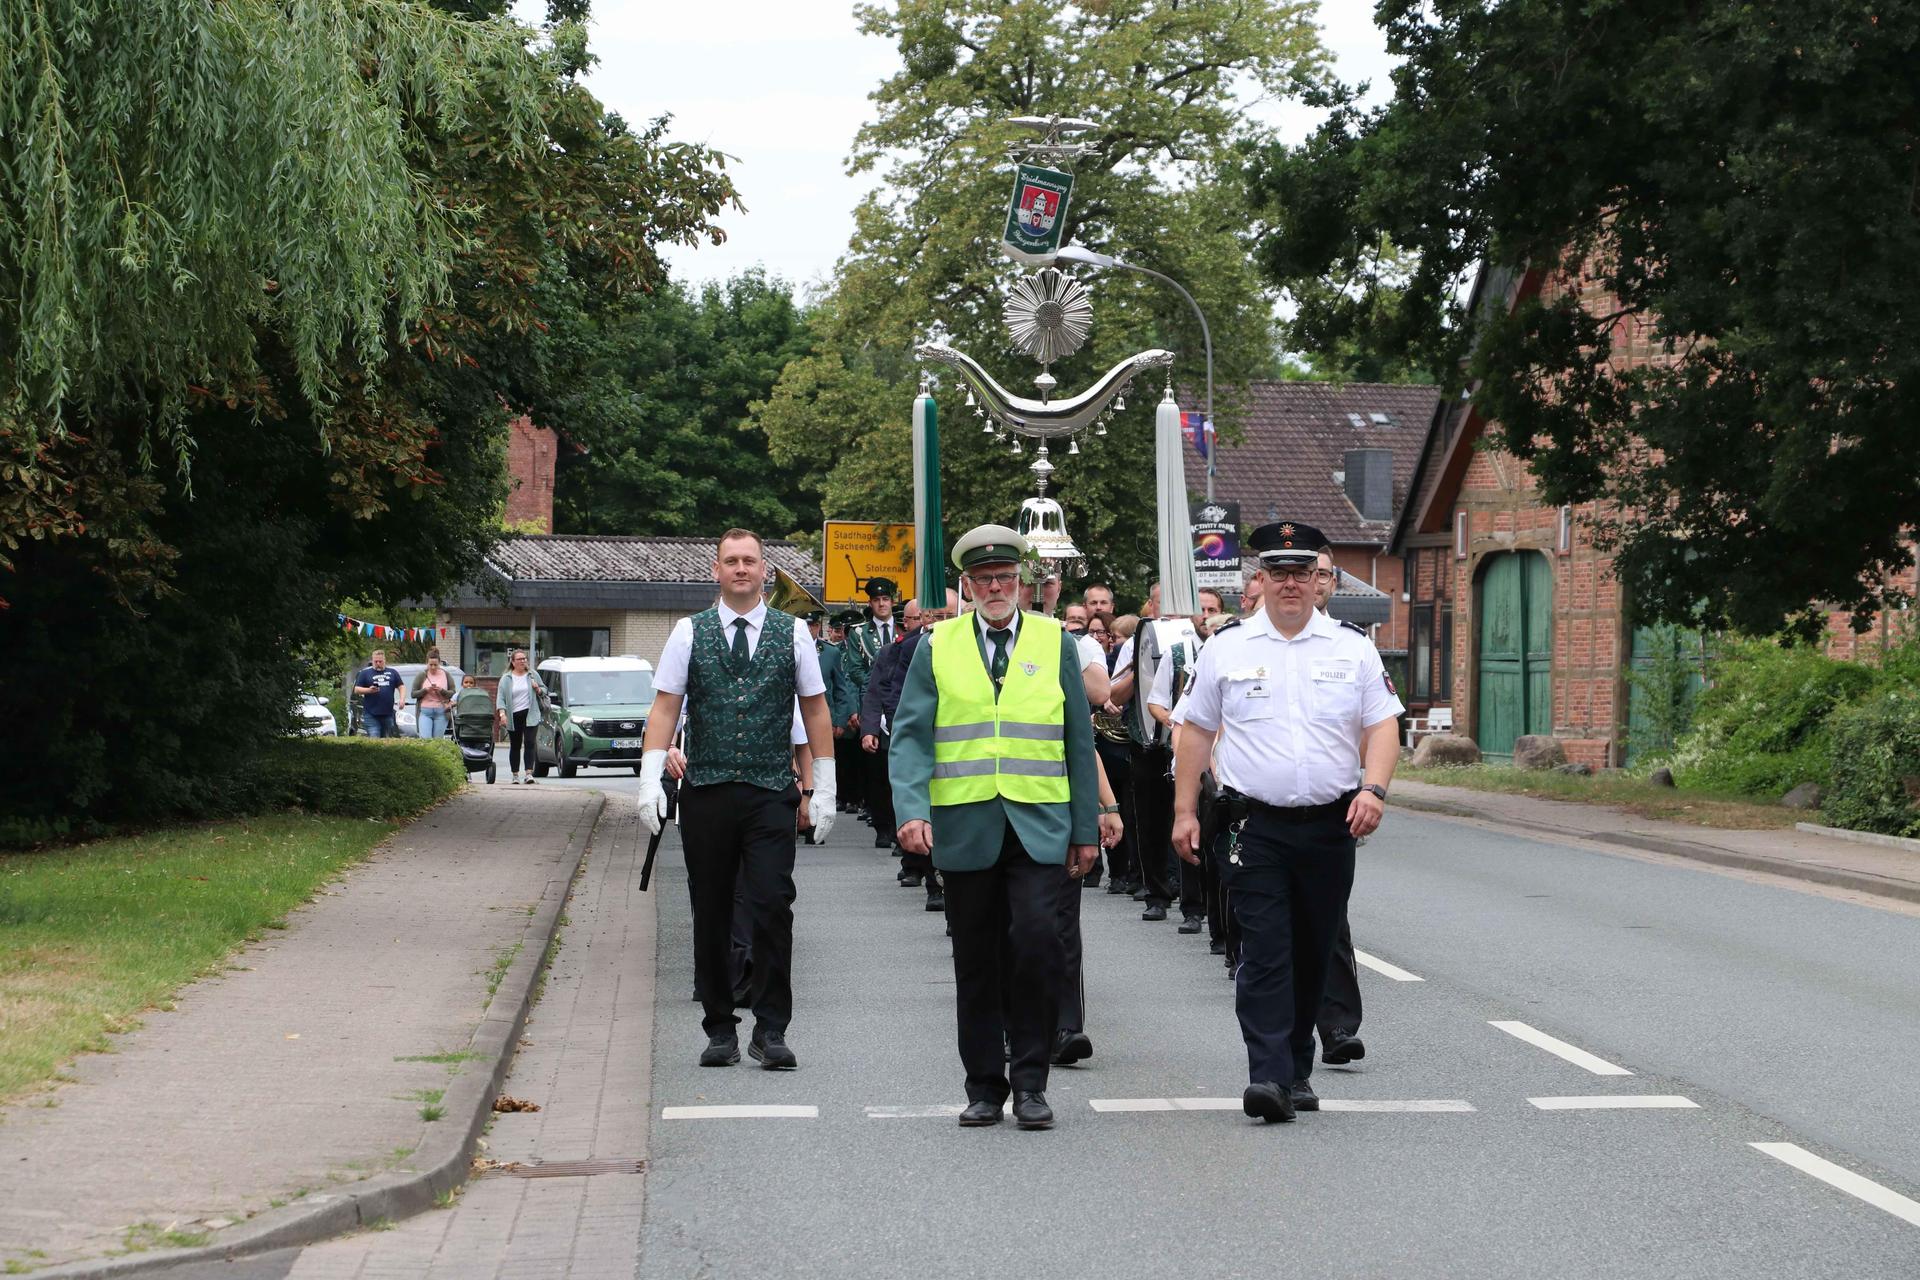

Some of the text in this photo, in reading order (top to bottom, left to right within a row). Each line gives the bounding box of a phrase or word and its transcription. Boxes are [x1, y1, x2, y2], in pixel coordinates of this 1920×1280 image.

[1219, 523, 1236, 533] PARK
[833, 531, 881, 541] Stadthage
[1195, 557, 1239, 568] achtgolf
[865, 563, 908, 573] Stolzenau
[1320, 671, 1346, 680] POLIZEI
